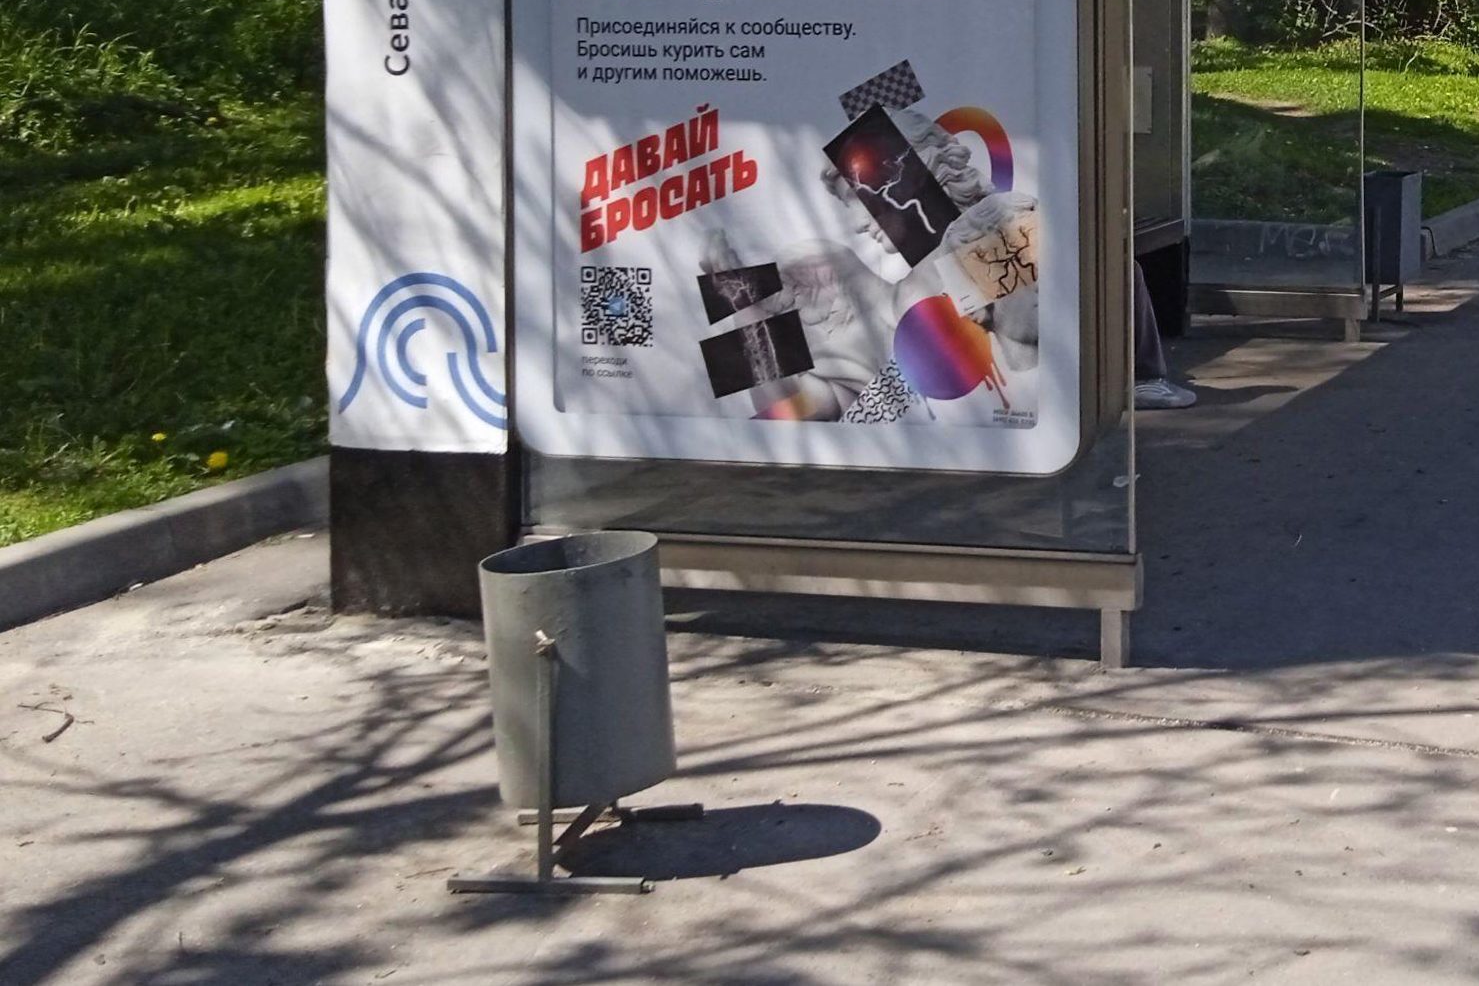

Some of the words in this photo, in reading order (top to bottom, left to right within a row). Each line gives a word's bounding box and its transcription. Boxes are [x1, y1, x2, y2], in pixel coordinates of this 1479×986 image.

[577, 16, 721, 37] Присоединяйся
[725, 21, 736, 35] к
[741, 17, 857, 40] сообществу.
[577, 40, 658, 61] Бросишь
[662, 43, 724, 62] курить
[729, 45, 766, 59] сам
[577, 67, 588, 80] и
[593, 66, 657, 84] другим
[662, 66, 768, 82] поможешь.
[581, 102, 719, 210] ДАВАЙ
[581, 150, 758, 254] БРОСАТЬ
